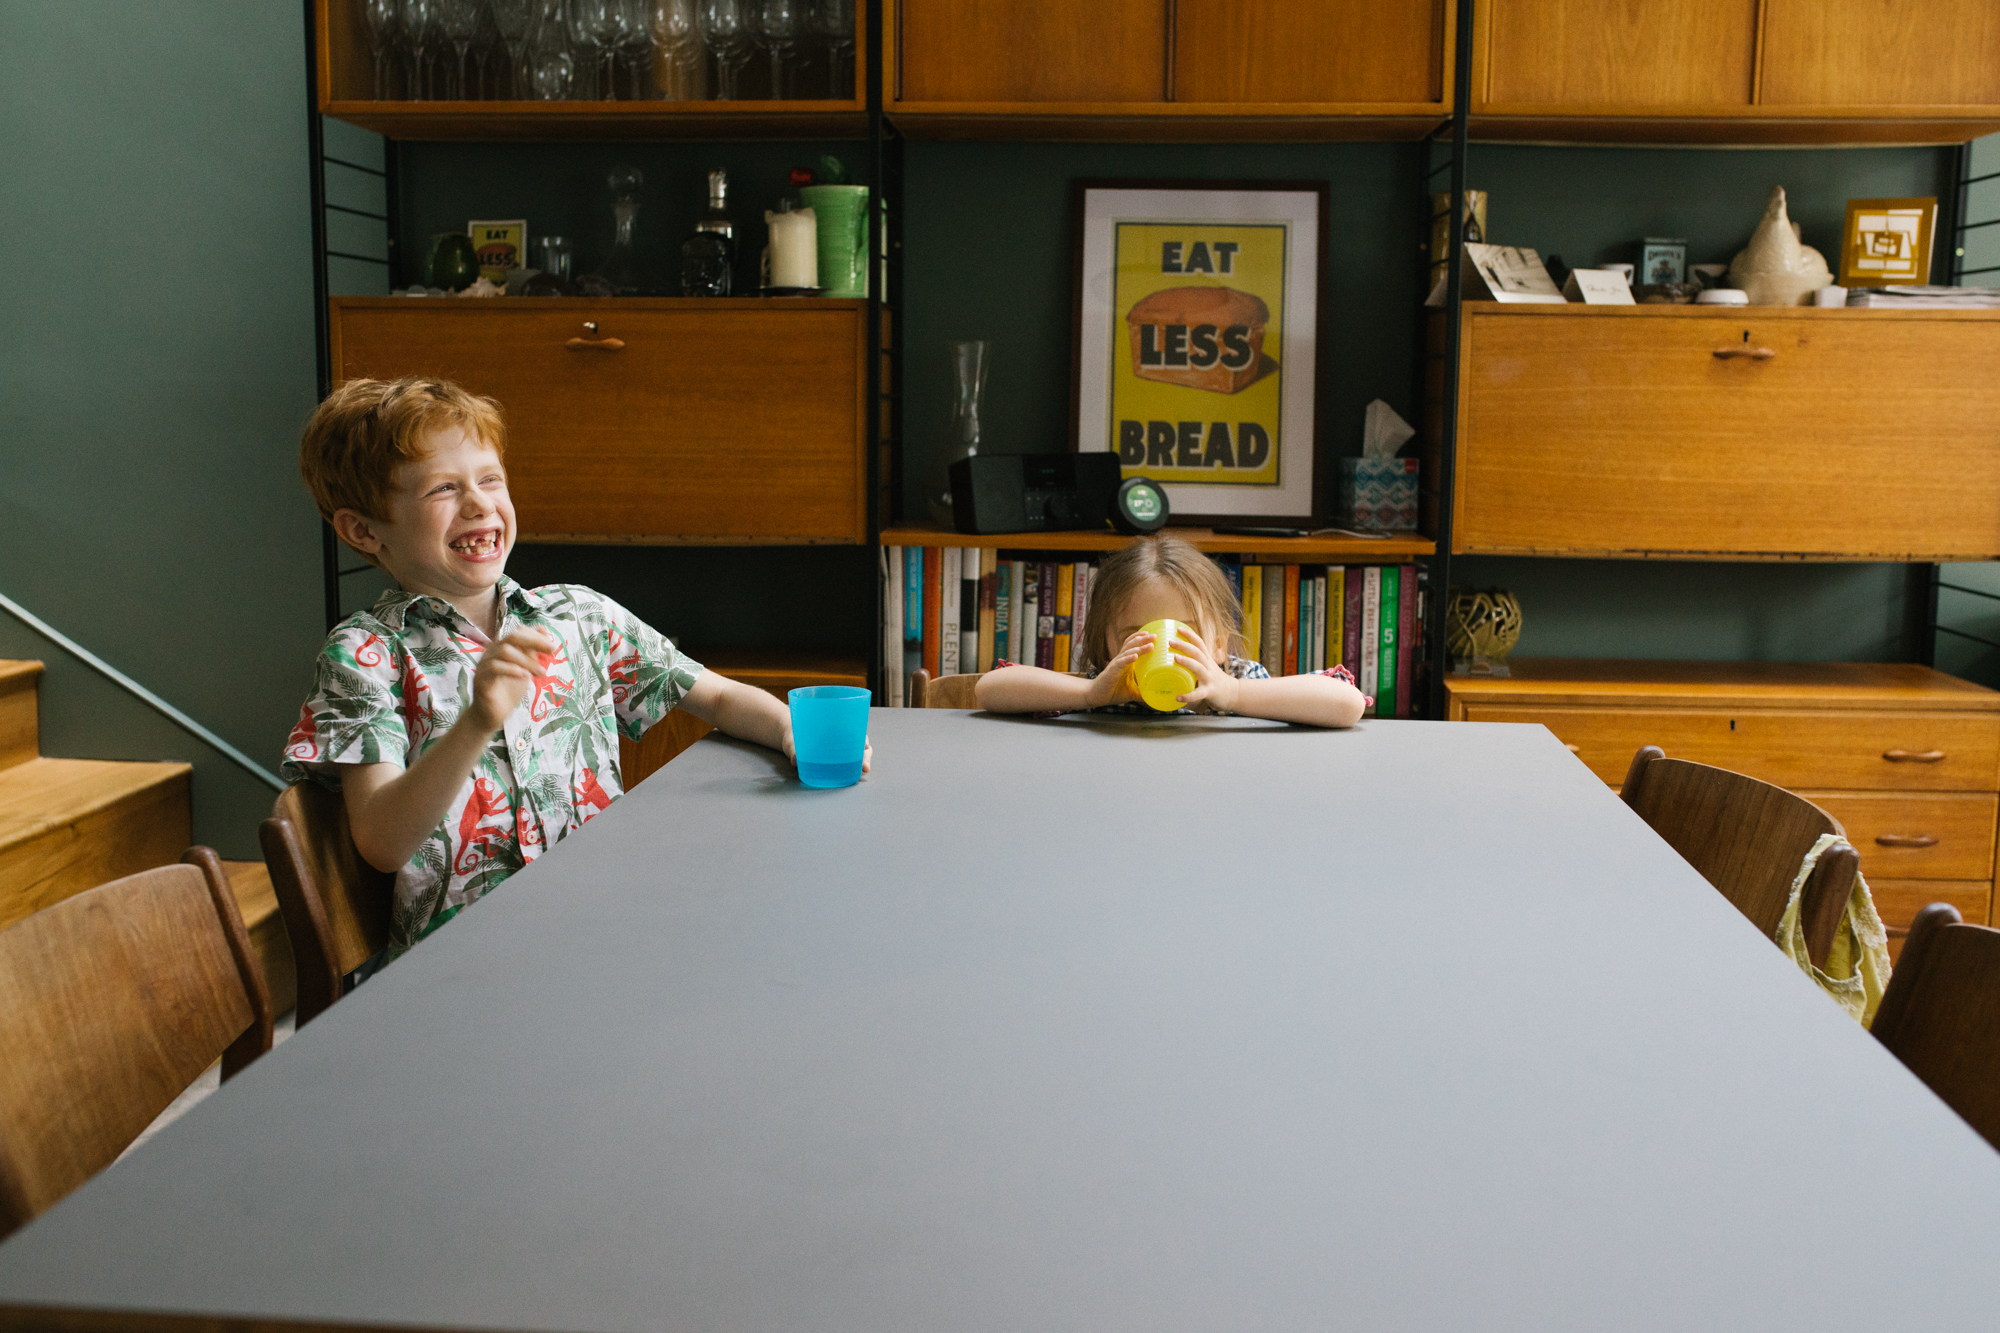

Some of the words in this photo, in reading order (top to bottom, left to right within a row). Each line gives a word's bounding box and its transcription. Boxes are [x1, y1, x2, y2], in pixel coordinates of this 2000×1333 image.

[486, 229, 509, 239] EAT
[480, 252, 512, 266] LESS
[1161, 241, 1239, 276] EAT
[1140, 323, 1255, 372] LESS
[1119, 419, 1271, 472] BREAD
[1044, 566, 1052, 587] JAMIE
[1044, 589, 1052, 615] OLIVER
[1367, 579, 1376, 606] LITTLE
[995, 596, 1009, 632] INDIA
[1269, 603, 1279, 647] NIGELLA
[1366, 608, 1375, 629] PARIS
[944, 622, 958, 674] PLENT
[1365, 632, 1374, 667] KITCHEN
[1383, 628, 1393, 644] 5
[1269, 651, 1277, 677] LAW
